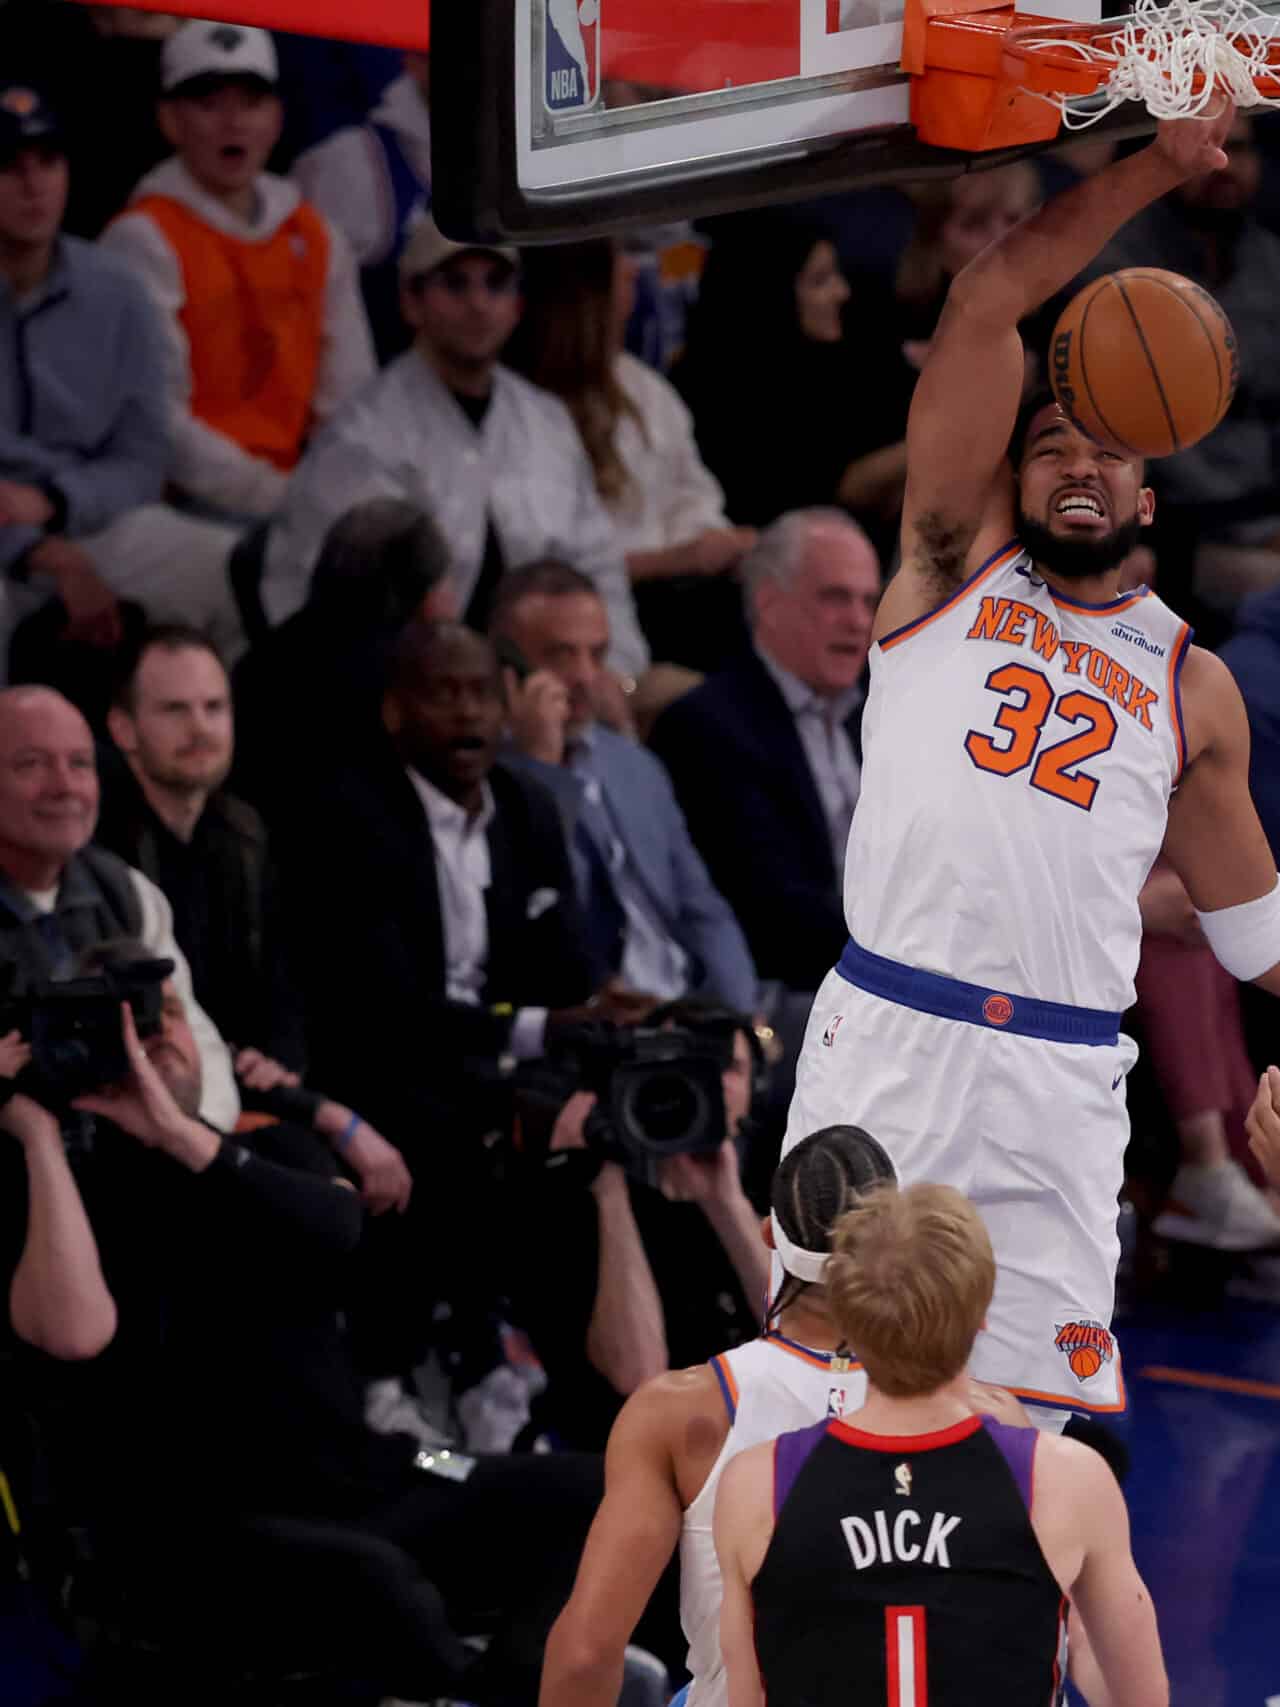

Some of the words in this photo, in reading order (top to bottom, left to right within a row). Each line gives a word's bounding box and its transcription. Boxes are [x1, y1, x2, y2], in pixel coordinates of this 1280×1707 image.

[551, 67, 578, 101] NBA
[966, 597, 1060, 663] NEW
[1059, 641, 1159, 732] YORK
[1111, 627, 1133, 643] abu
[1134, 637, 1167, 657] dhabi
[964, 662, 1119, 812] 32
[840, 1509, 962, 1570] DICK
[884, 1605, 929, 1707] 1
